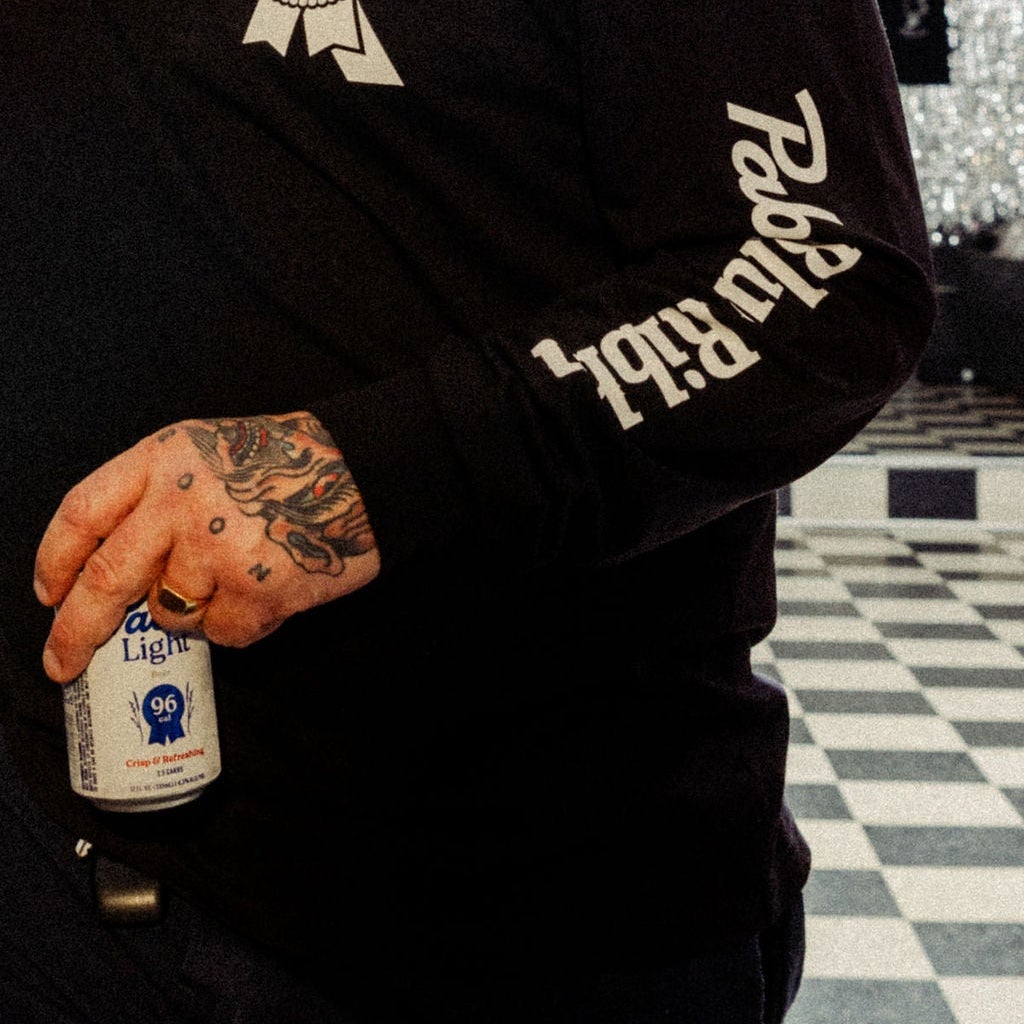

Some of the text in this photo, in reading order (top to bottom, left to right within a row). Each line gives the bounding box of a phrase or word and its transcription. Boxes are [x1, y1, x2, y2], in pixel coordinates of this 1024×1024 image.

[726, 87, 844, 240] Pab
[712, 236, 863, 324] Blu
[121, 630, 191, 666] Light
[150, 693, 178, 716] 96
[125, 758, 151, 769] Crisp
[162, 747, 205, 764] Refreshing
